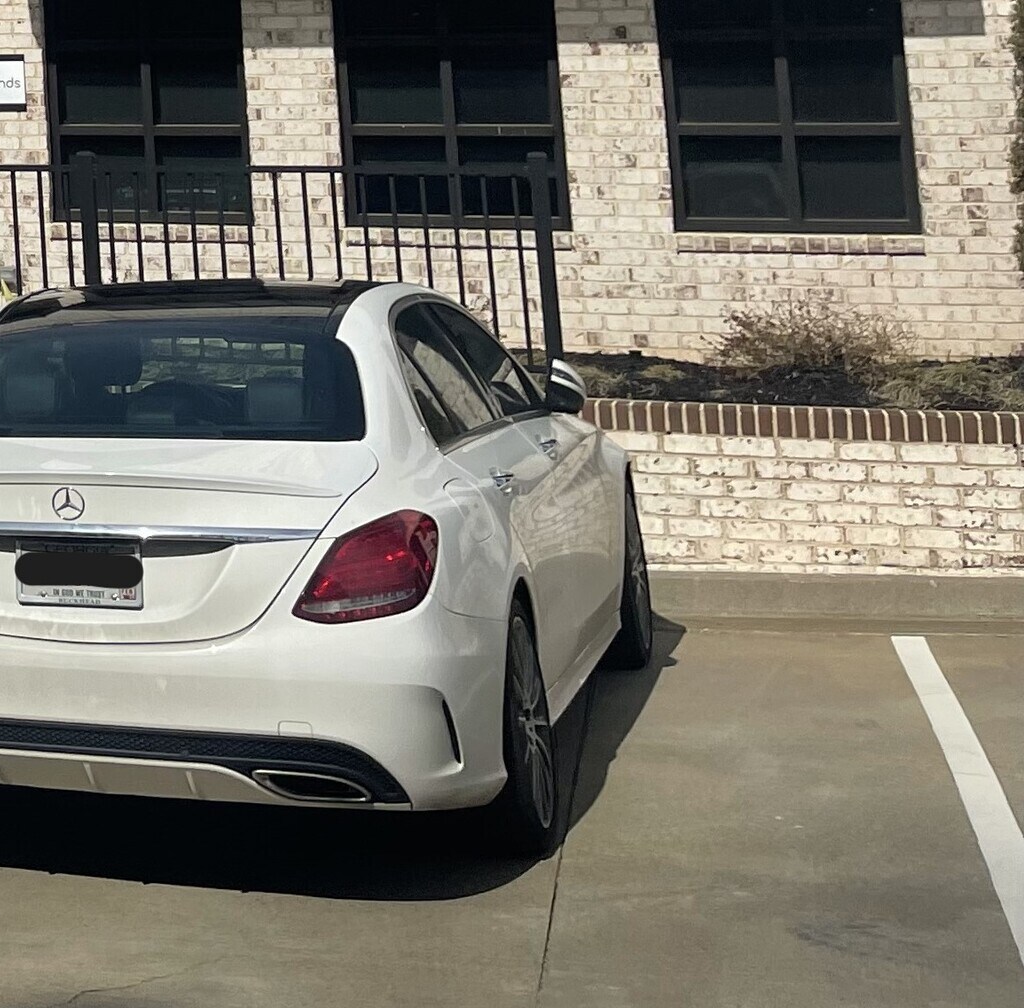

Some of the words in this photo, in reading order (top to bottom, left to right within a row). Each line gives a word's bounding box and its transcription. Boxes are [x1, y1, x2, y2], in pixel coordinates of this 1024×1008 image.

[62, 589, 74, 597] GOD
[75, 589, 84, 597] WE
[86, 589, 105, 599] TRUST
